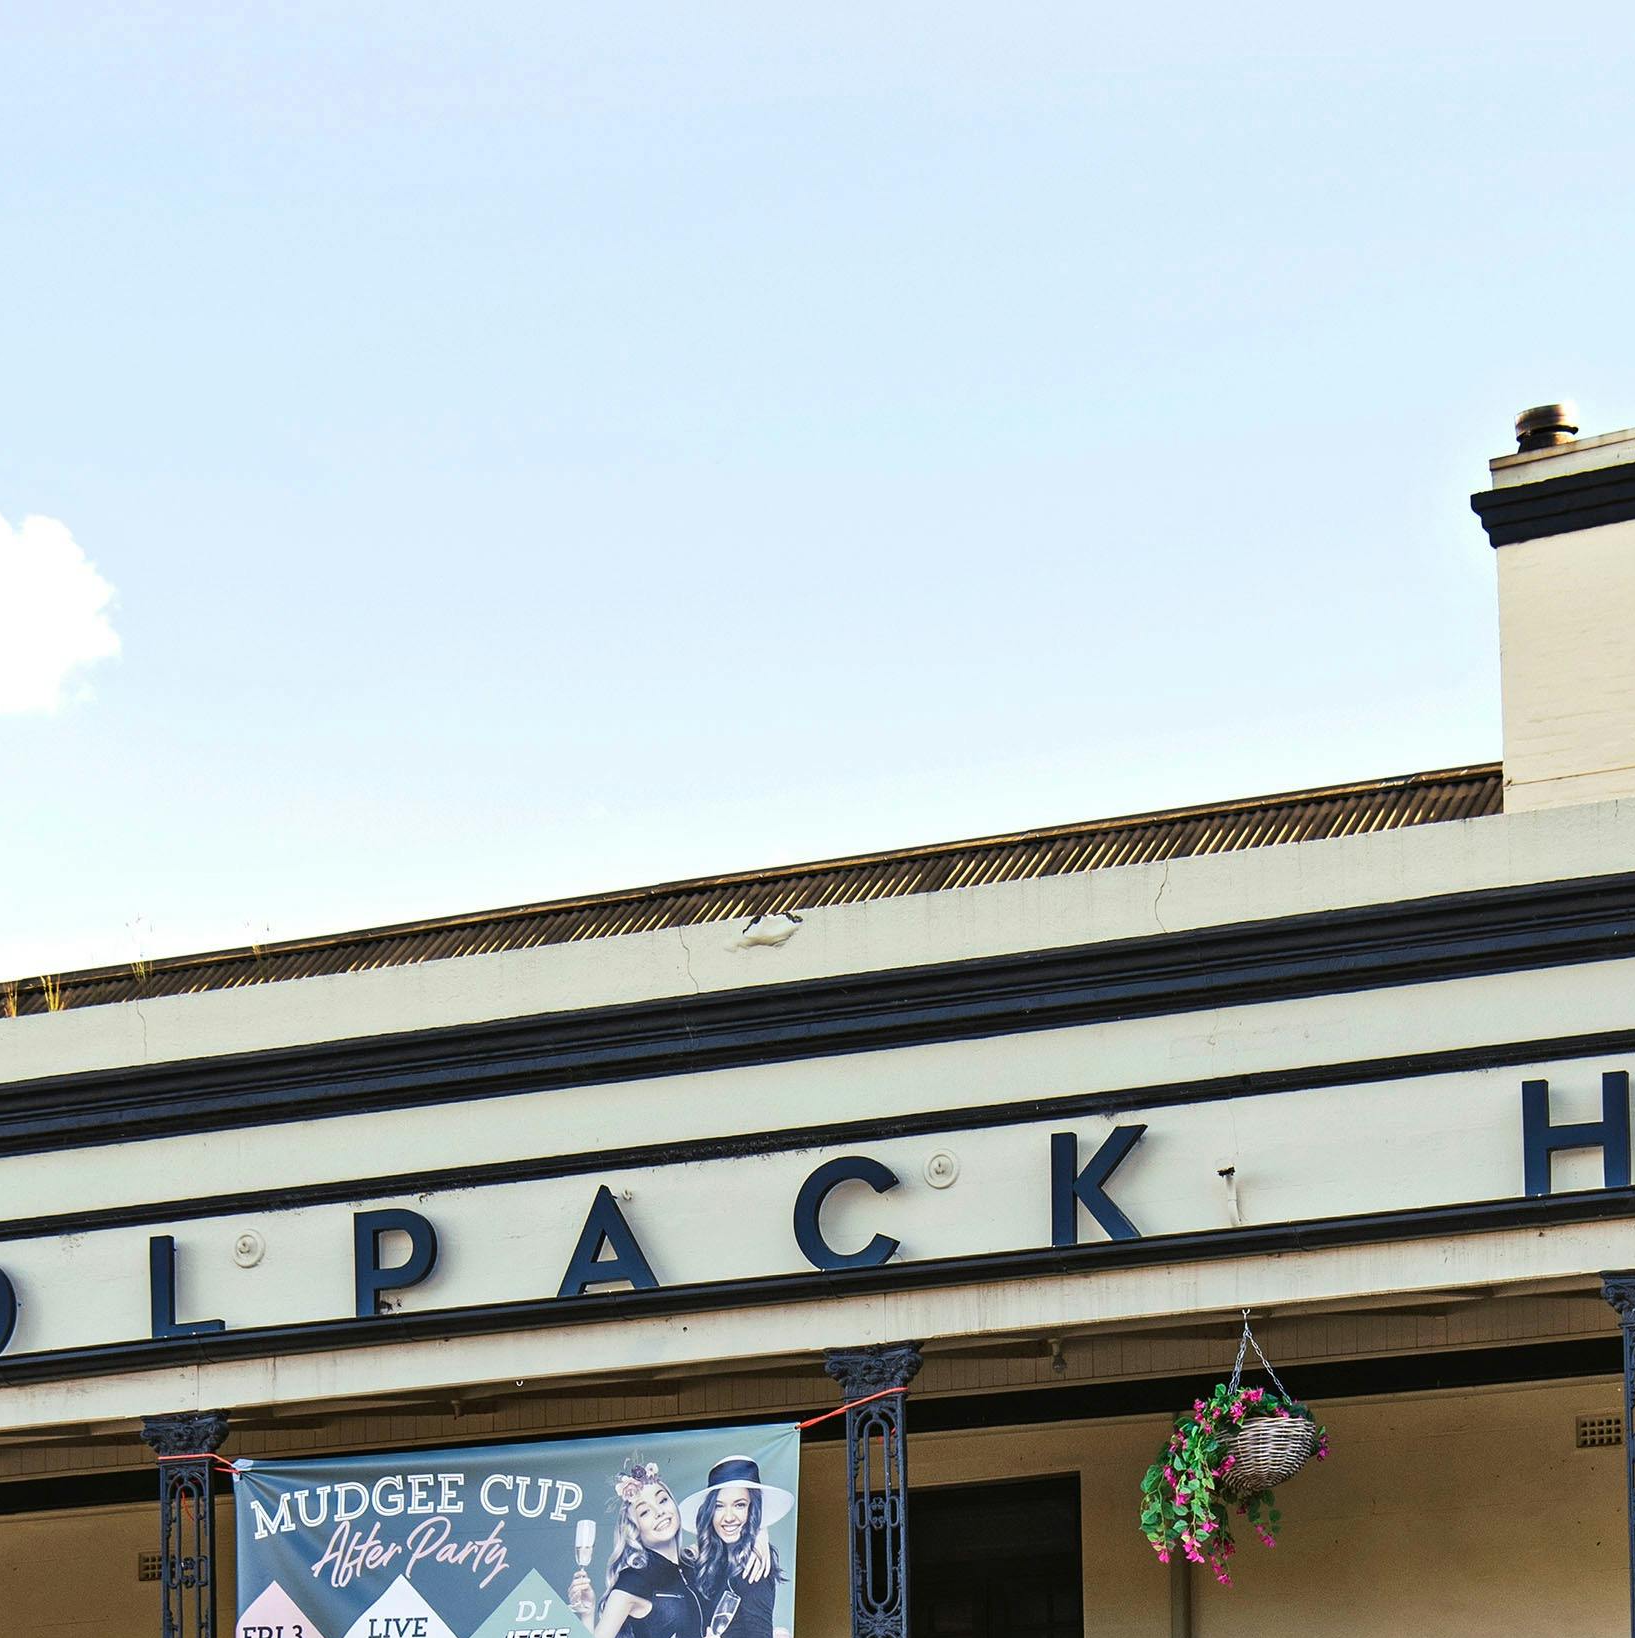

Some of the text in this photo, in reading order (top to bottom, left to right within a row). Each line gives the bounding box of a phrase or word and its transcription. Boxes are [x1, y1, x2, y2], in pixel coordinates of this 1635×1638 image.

[250, 1473, 583, 1540] MUDGEE CUP
[313, 1516, 510, 1589] After Party
[515, 1599, 551, 1623] DJ
